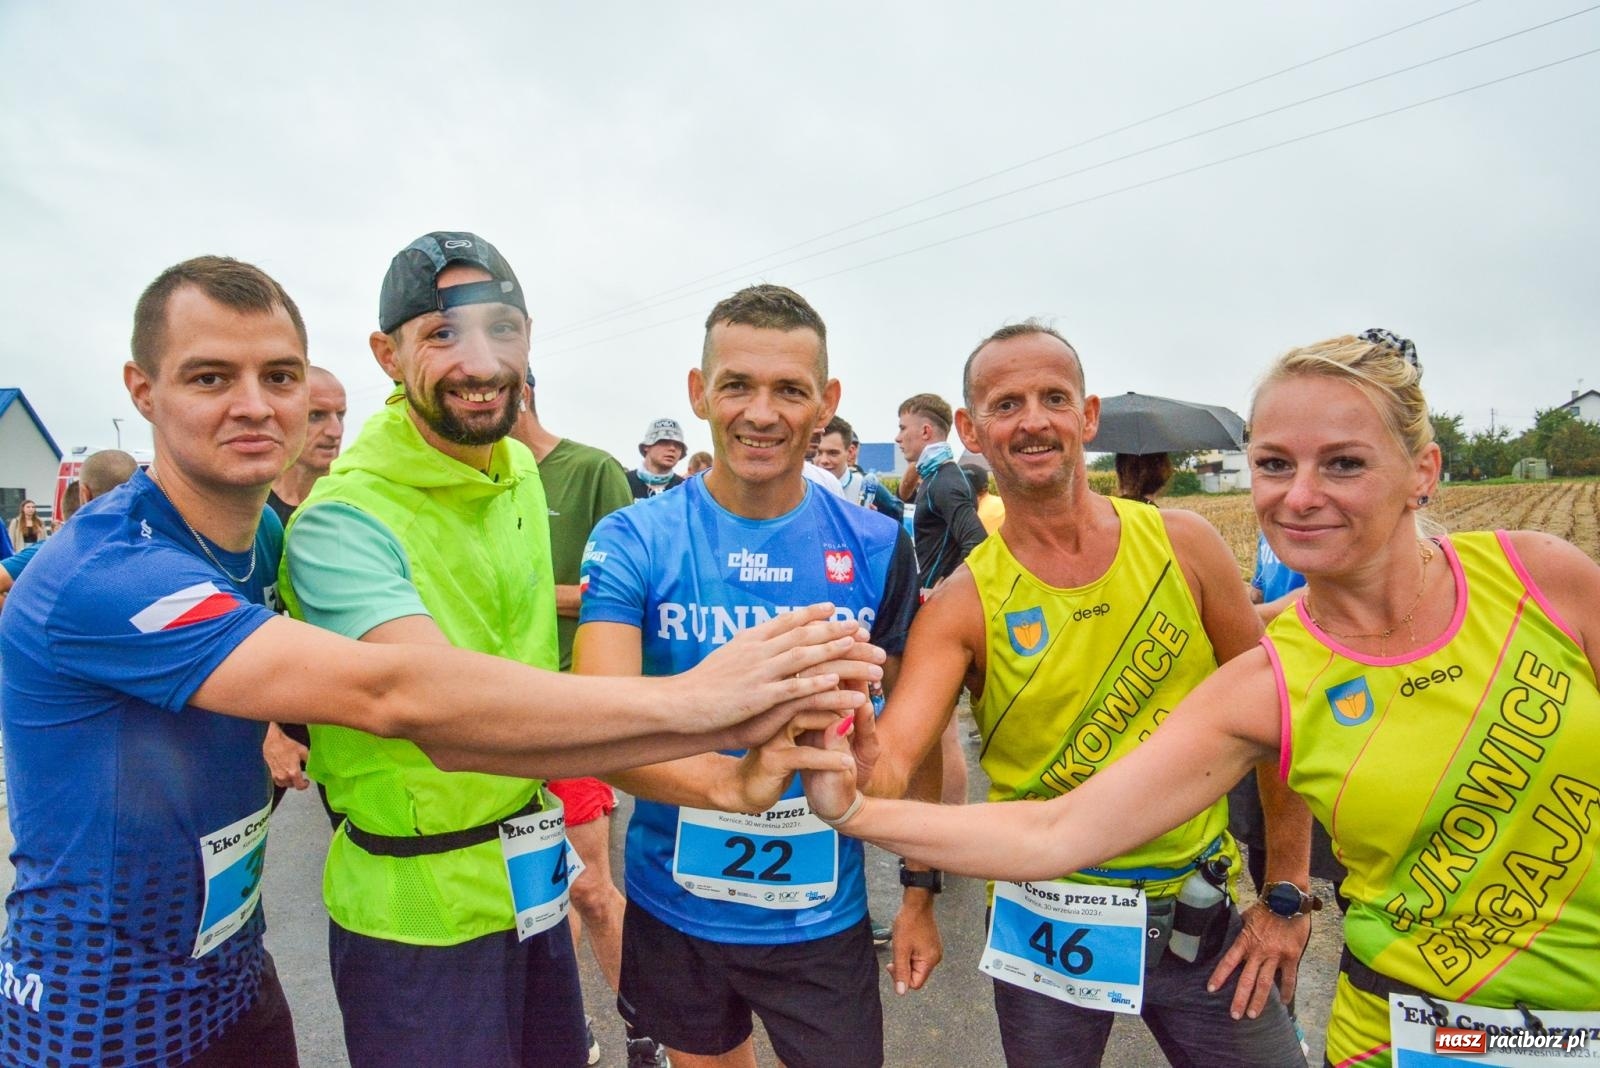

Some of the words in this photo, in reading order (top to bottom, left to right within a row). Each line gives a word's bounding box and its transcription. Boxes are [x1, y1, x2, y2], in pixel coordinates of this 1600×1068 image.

[728, 548, 768, 567] eko
[740, 567, 793, 582] okna
[1073, 603, 1110, 621] deep
[1400, 664, 1463, 697] deep
[1024, 610, 1190, 800] JKOWICE
[766, 808, 805, 821] przez
[212, 836, 241, 856] Eko
[722, 835, 793, 881] 22
[1025, 882, 1060, 902] Cross
[1064, 894, 1107, 905] przez
[1111, 894, 1138, 908] Las
[1029, 921, 1094, 976] 46
